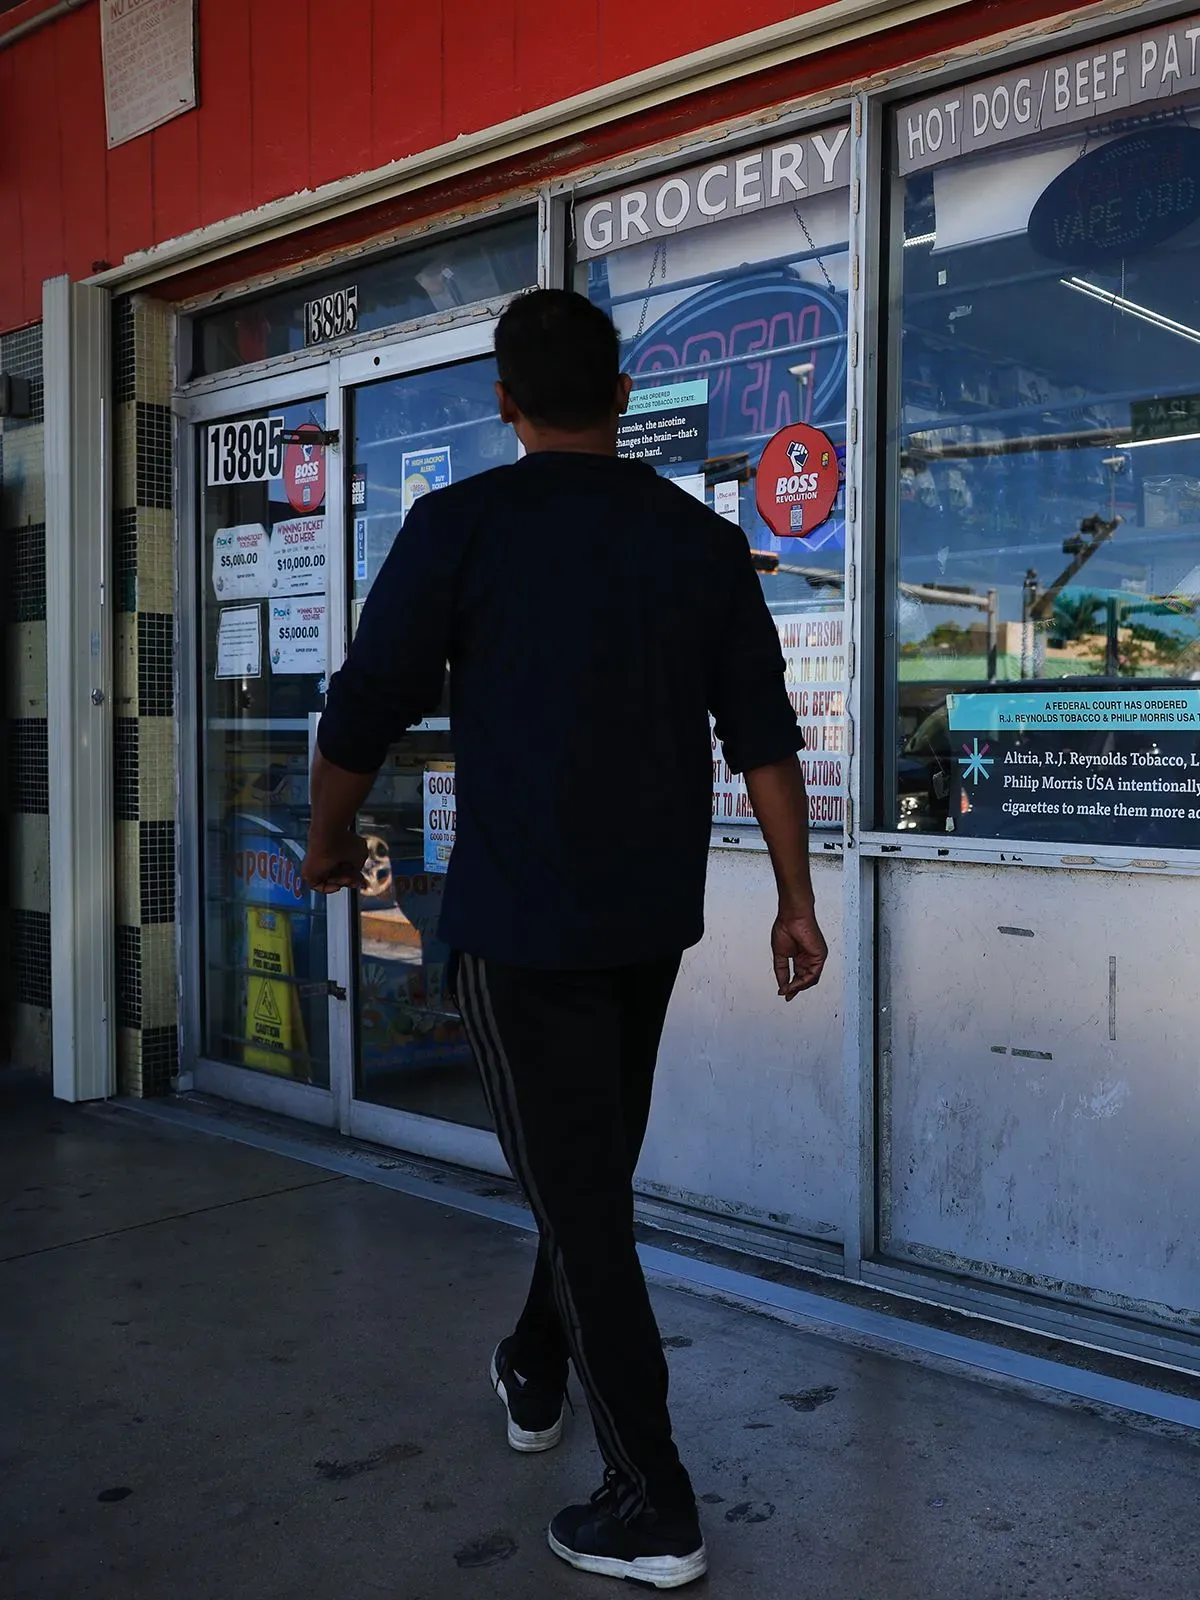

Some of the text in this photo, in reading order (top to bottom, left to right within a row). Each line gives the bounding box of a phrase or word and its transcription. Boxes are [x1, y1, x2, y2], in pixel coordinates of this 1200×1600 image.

[907, 99, 961, 160] HOT
[972, 47, 1128, 138] DOG/BEEF
[583, 127, 850, 251] GROCERY
[1053, 196, 1123, 249] VAPE
[1135, 176, 1196, 222] CBD
[306, 288, 357, 346] 13895
[648, 390, 671, 400] ORDERED
[651, 399, 673, 407] TOBACCO
[621, 422, 645, 433] smoke,
[645, 420, 657, 430] the
[657, 416, 686, 426] nicotine
[641, 434, 653, 444] the
[211, 419, 283, 482] 13895
[629, 450, 635, 459] is
[644, 446, 663, 457] hard.
[411, 455, 445, 466] HIGH JACKPOT
[294, 461, 319, 479] BOSS
[351, 480, 365, 494] SOLD
[775, 473, 819, 496] BOSS
[351, 492, 365, 505] HERE
[775, 491, 818, 504] REVOLUTION
[277, 519, 324, 535] WINNING TICKET
[284, 531, 315, 545] SOLD HERE
[220, 552, 258, 569] $5,000.00
[277, 553, 326, 572] $10,000.00
[278, 626, 319, 640] $5,000.00
[783, 623, 801, 648] ANY
[805, 620, 843, 647] PERSON
[800, 657, 810, 682] IN
[815, 656, 828, 682] AN
[812, 690, 845, 717] BEVER
[1045, 700, 1188, 710] A FEDERAL COURT HAS ORDERED
[999, 714, 1014, 723] R.J.
[1015, 714, 1059, 723] REYNOLDS
[1060, 713, 1101, 722] TOBACCO
[1102, 713, 1109, 722] &
[1111, 713, 1138, 722] PHILIP
[1140, 713, 1174, 722] MORRIS
[1176, 713, 1194, 722] USA
[822, 725, 845, 751] FEET
[1003, 751, 1042, 767] Altria,
[1045, 751, 1067, 767] R.J.
[1069, 751, 1128, 768] Reynolds
[1130, 752, 1187, 769] Tobacco,
[801, 760, 841, 786] OLATORS
[1003, 775, 1039, 792] Philip
[1041, 776, 1083, 790] Morris
[1086, 776, 1115, 791] USA
[723, 792, 733, 817] TO
[1002, 799, 1060, 816] cigarettes
[1062, 802, 1075, 815] to
[1076, 802, 1111, 816] make
[1113, 803, 1148, 817] them
[1150, 807, 1186, 820] more
[430, 833, 443, 841] GOOD
